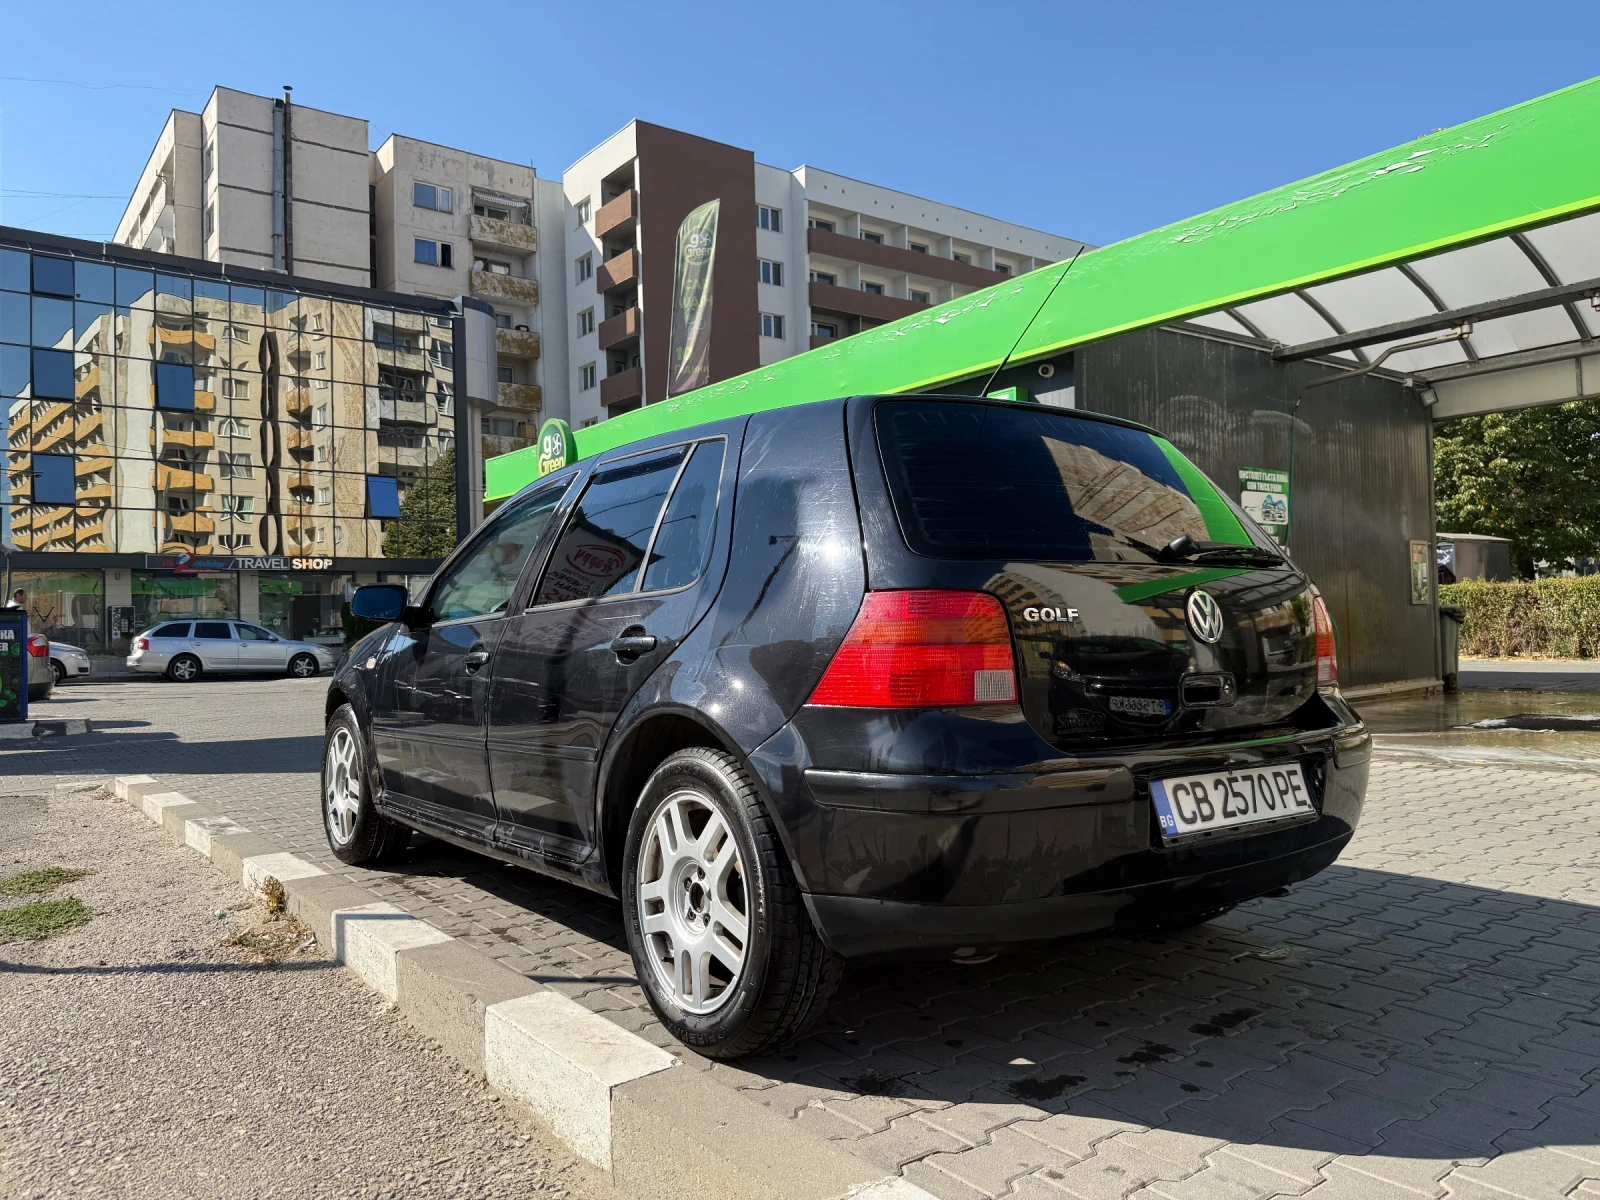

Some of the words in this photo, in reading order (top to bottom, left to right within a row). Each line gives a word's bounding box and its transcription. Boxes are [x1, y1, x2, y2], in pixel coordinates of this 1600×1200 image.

[539, 454, 564, 477] Green
[192, 560, 225, 569] Holiday
[236, 558, 288, 569] TRAVEL
[292, 558, 332, 569] SHOP
[1023, 607, 1079, 622] GOLF
[1172, 781, 1215, 825] CB
[1213, 773, 1276, 819] 2570
[1272, 769, 1308, 809] PE
[1159, 815, 1174, 828] BG
